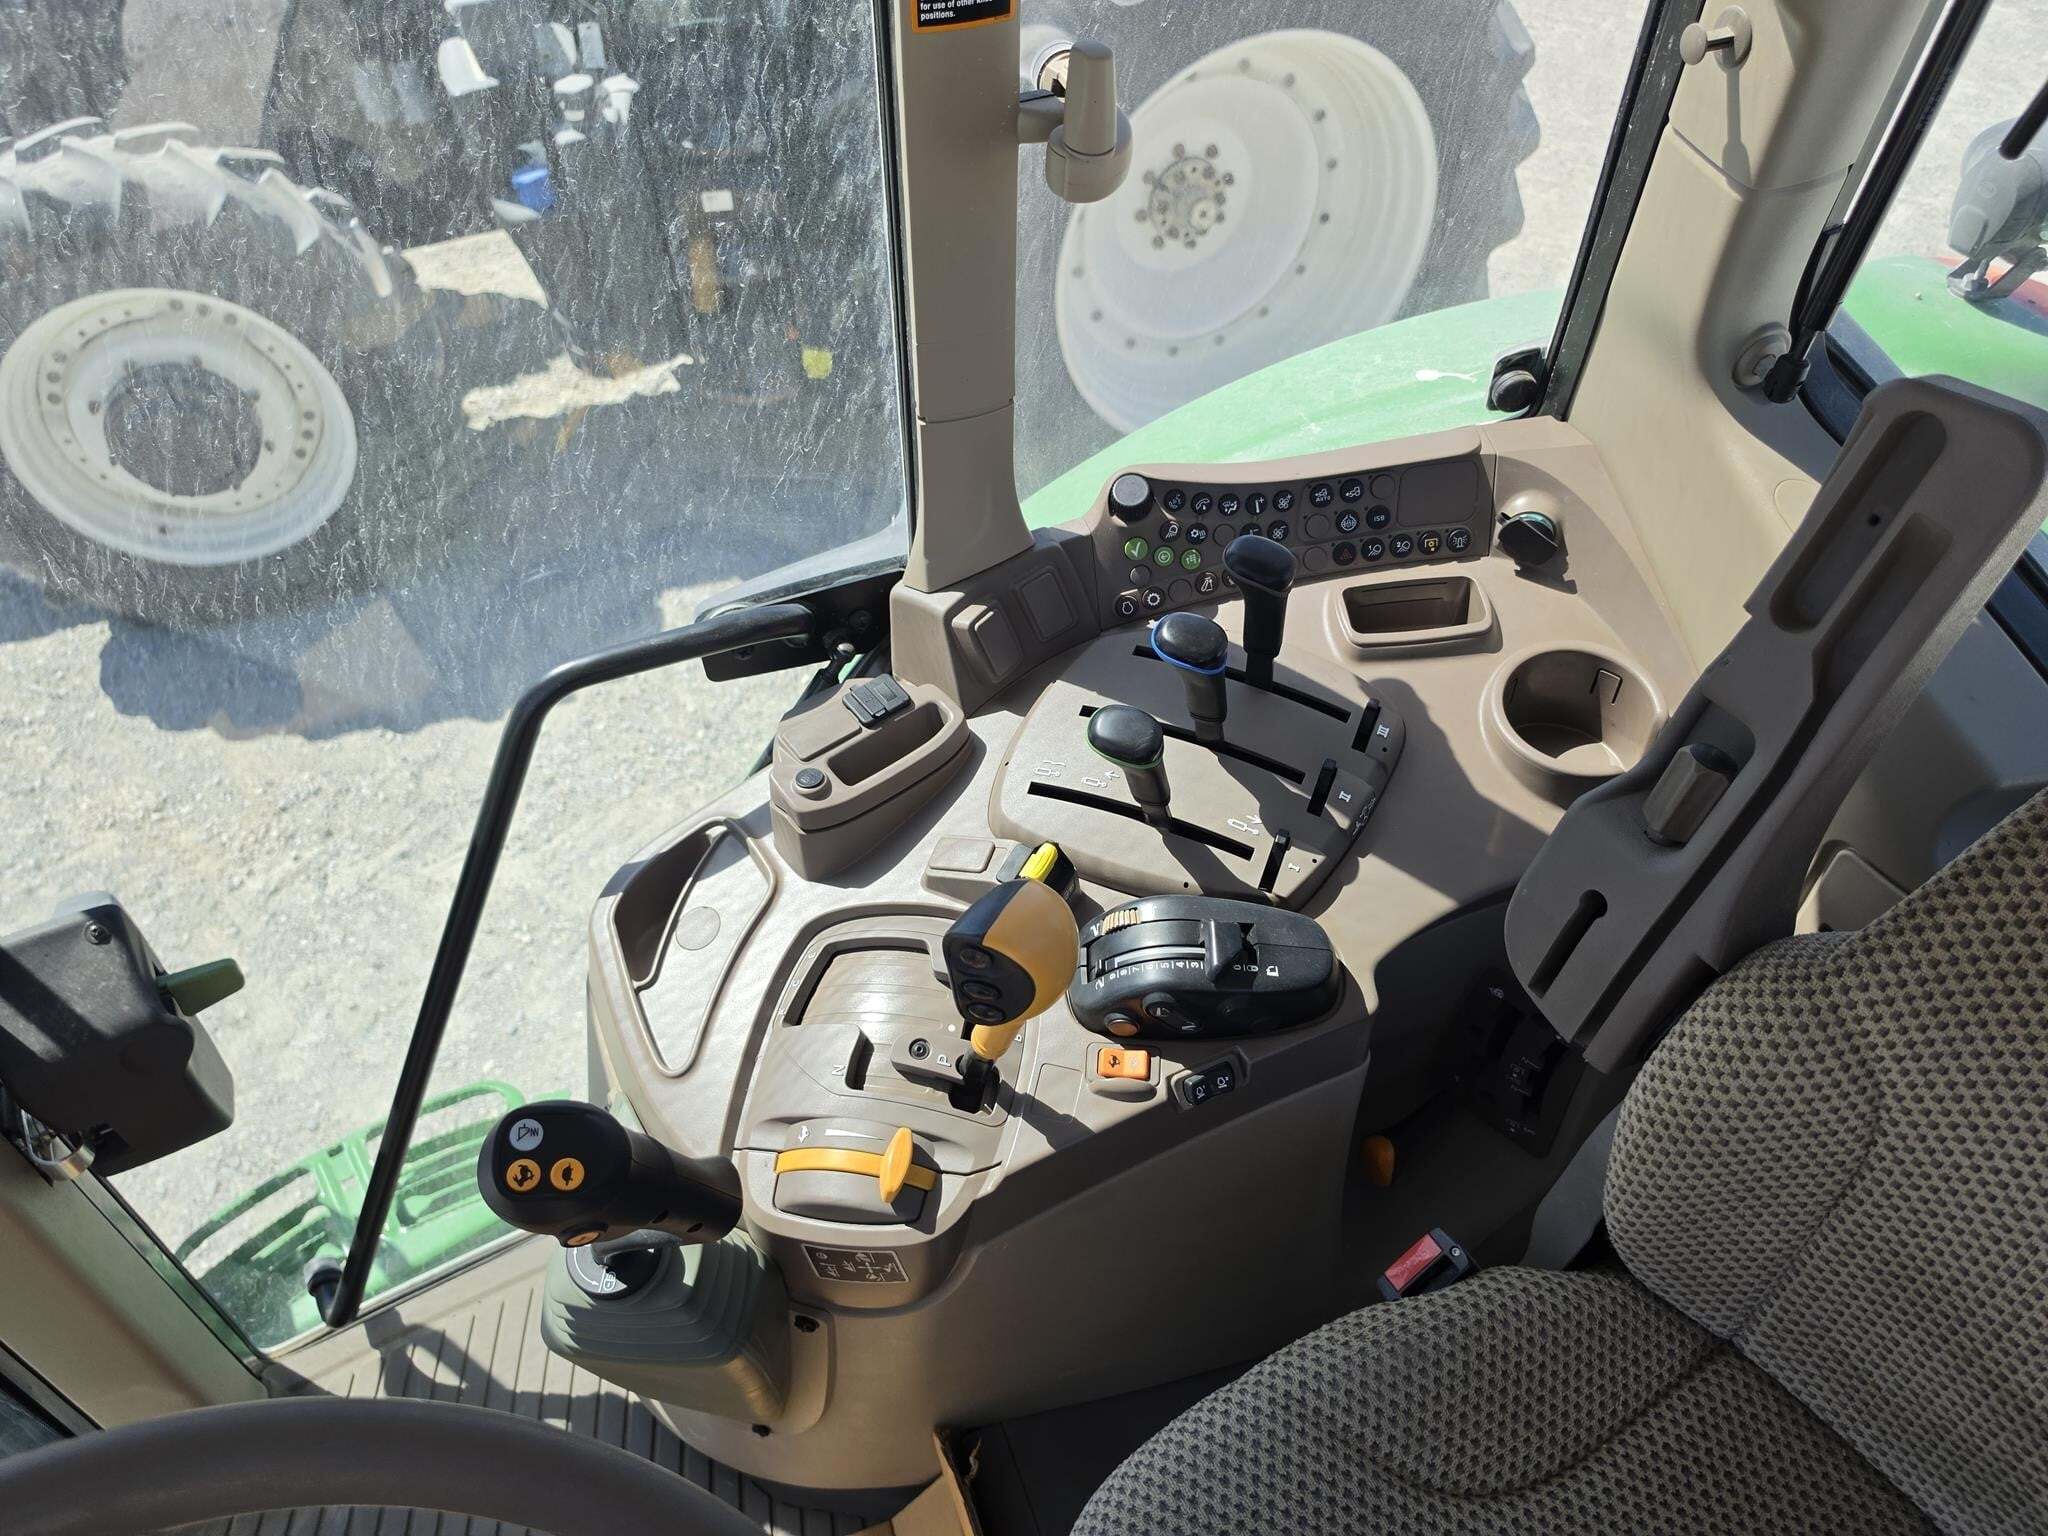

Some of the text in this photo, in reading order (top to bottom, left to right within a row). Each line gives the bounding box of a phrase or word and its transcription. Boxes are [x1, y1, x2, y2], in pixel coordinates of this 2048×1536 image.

[947, 0, 955, 8] of
[920, 10, 956, 21] positions.
[936, 1054, 951, 1068] P
[831, 1064, 846, 1077] N
